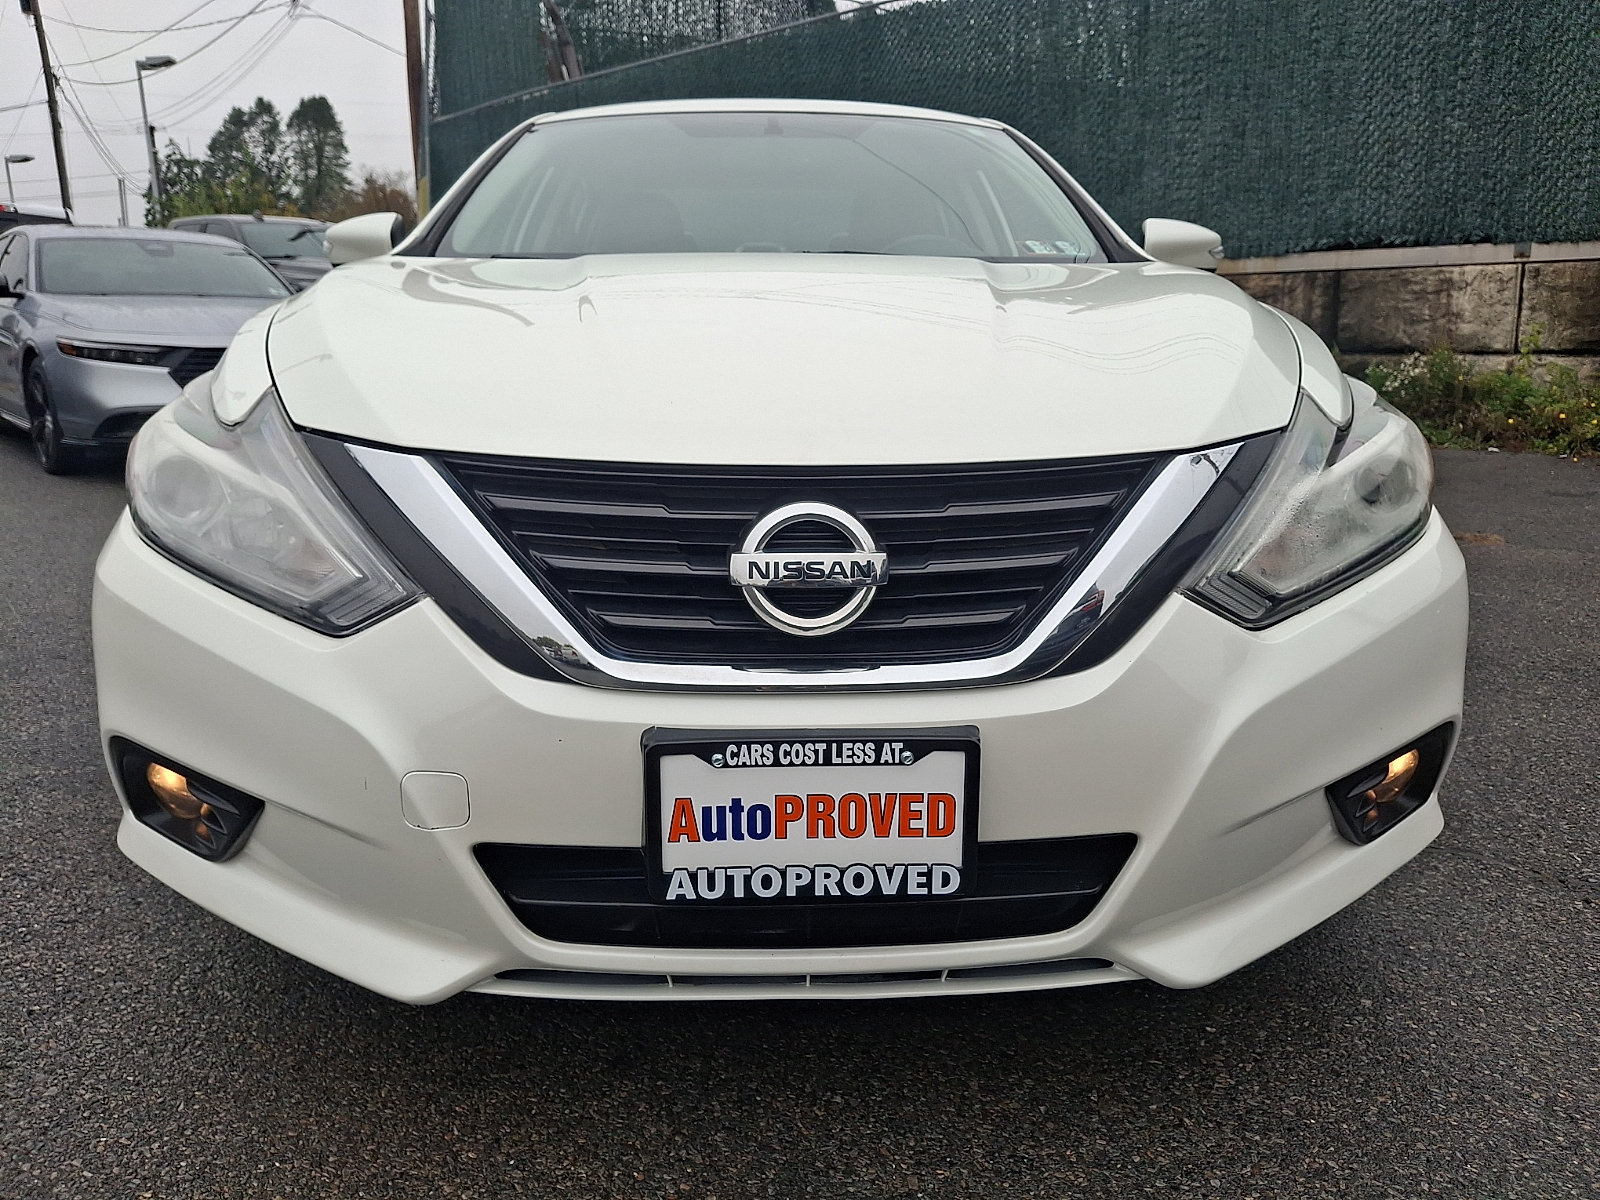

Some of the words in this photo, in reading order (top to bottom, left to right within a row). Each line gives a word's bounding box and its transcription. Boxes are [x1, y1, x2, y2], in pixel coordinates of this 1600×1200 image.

[748, 560, 872, 580] NISSAN
[726, 745, 774, 766] CARS
[779, 743, 827, 765] COST
[832, 743, 875, 764] LESS
[880, 742, 903, 764] AT
[667, 792, 957, 843] AutoPROVED
[665, 864, 961, 900] AUTOPROVED
